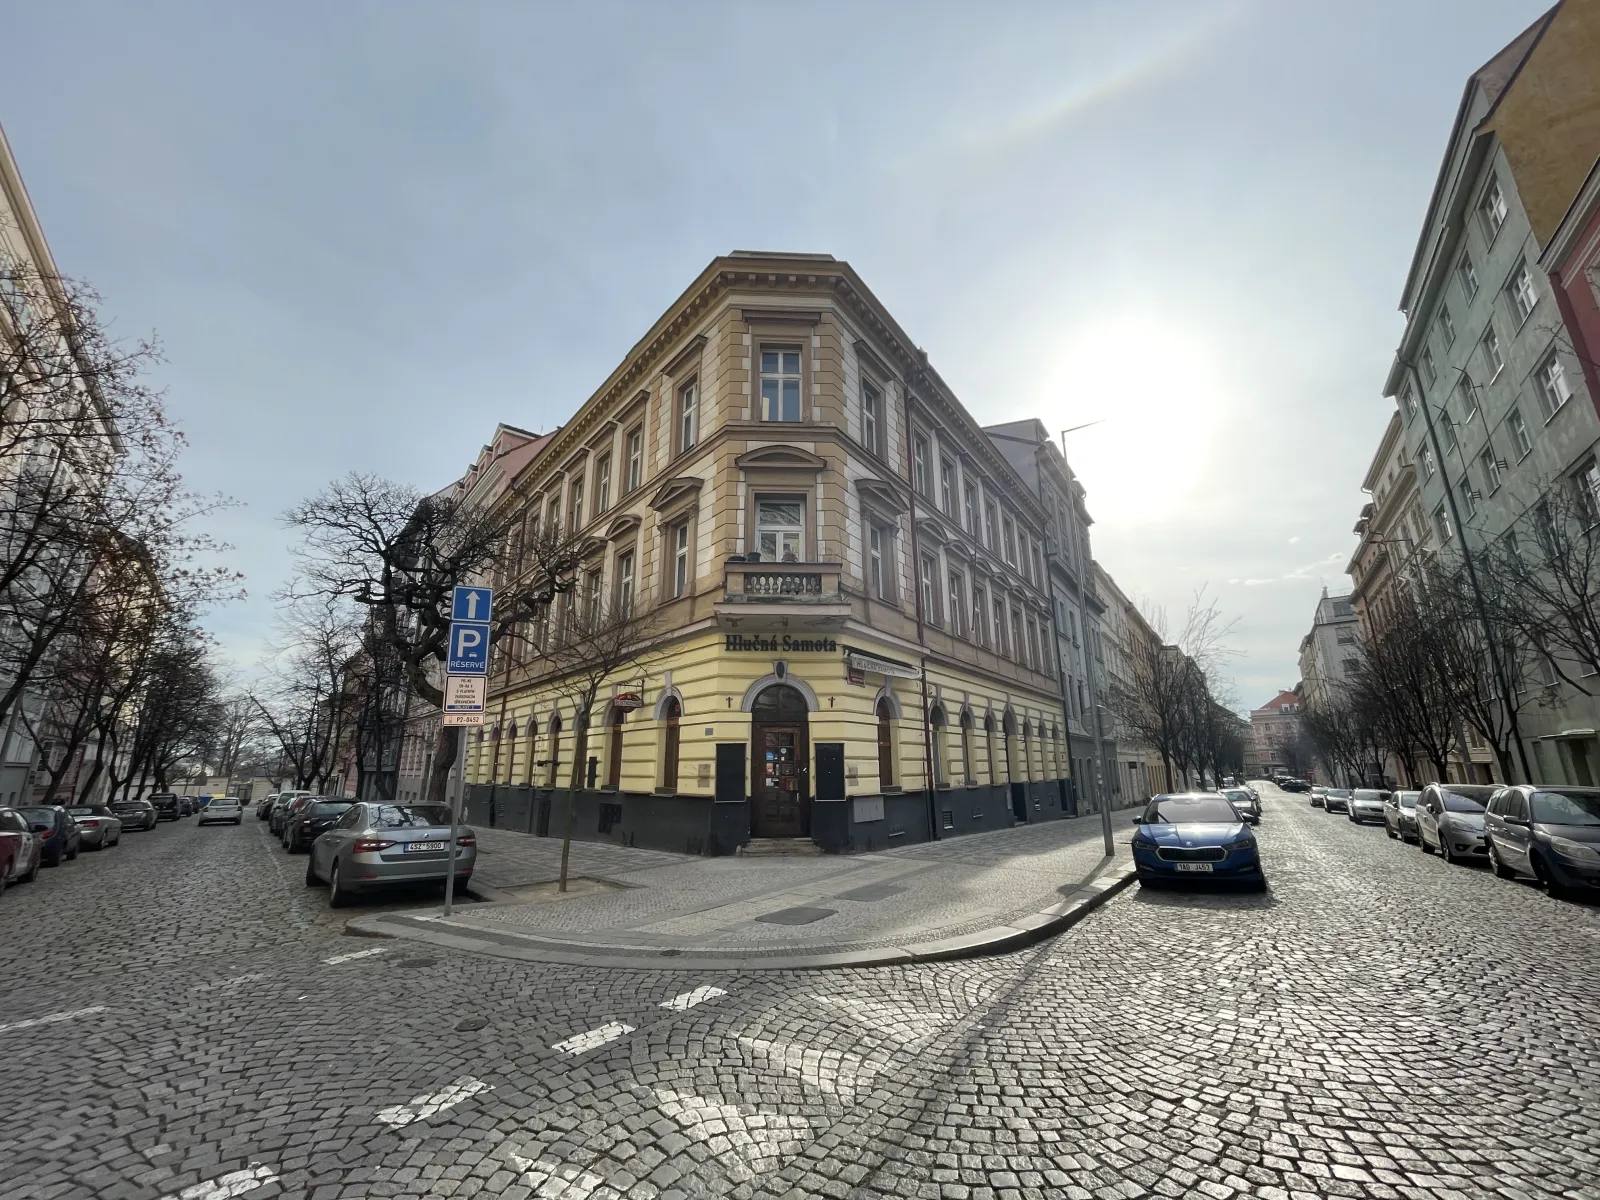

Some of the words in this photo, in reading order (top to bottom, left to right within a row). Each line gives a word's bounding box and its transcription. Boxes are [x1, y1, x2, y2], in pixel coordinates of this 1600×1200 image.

[457, 629, 481, 658] P
[725, 634, 778, 652] Hlučná
[782, 634, 837, 652] Samota
